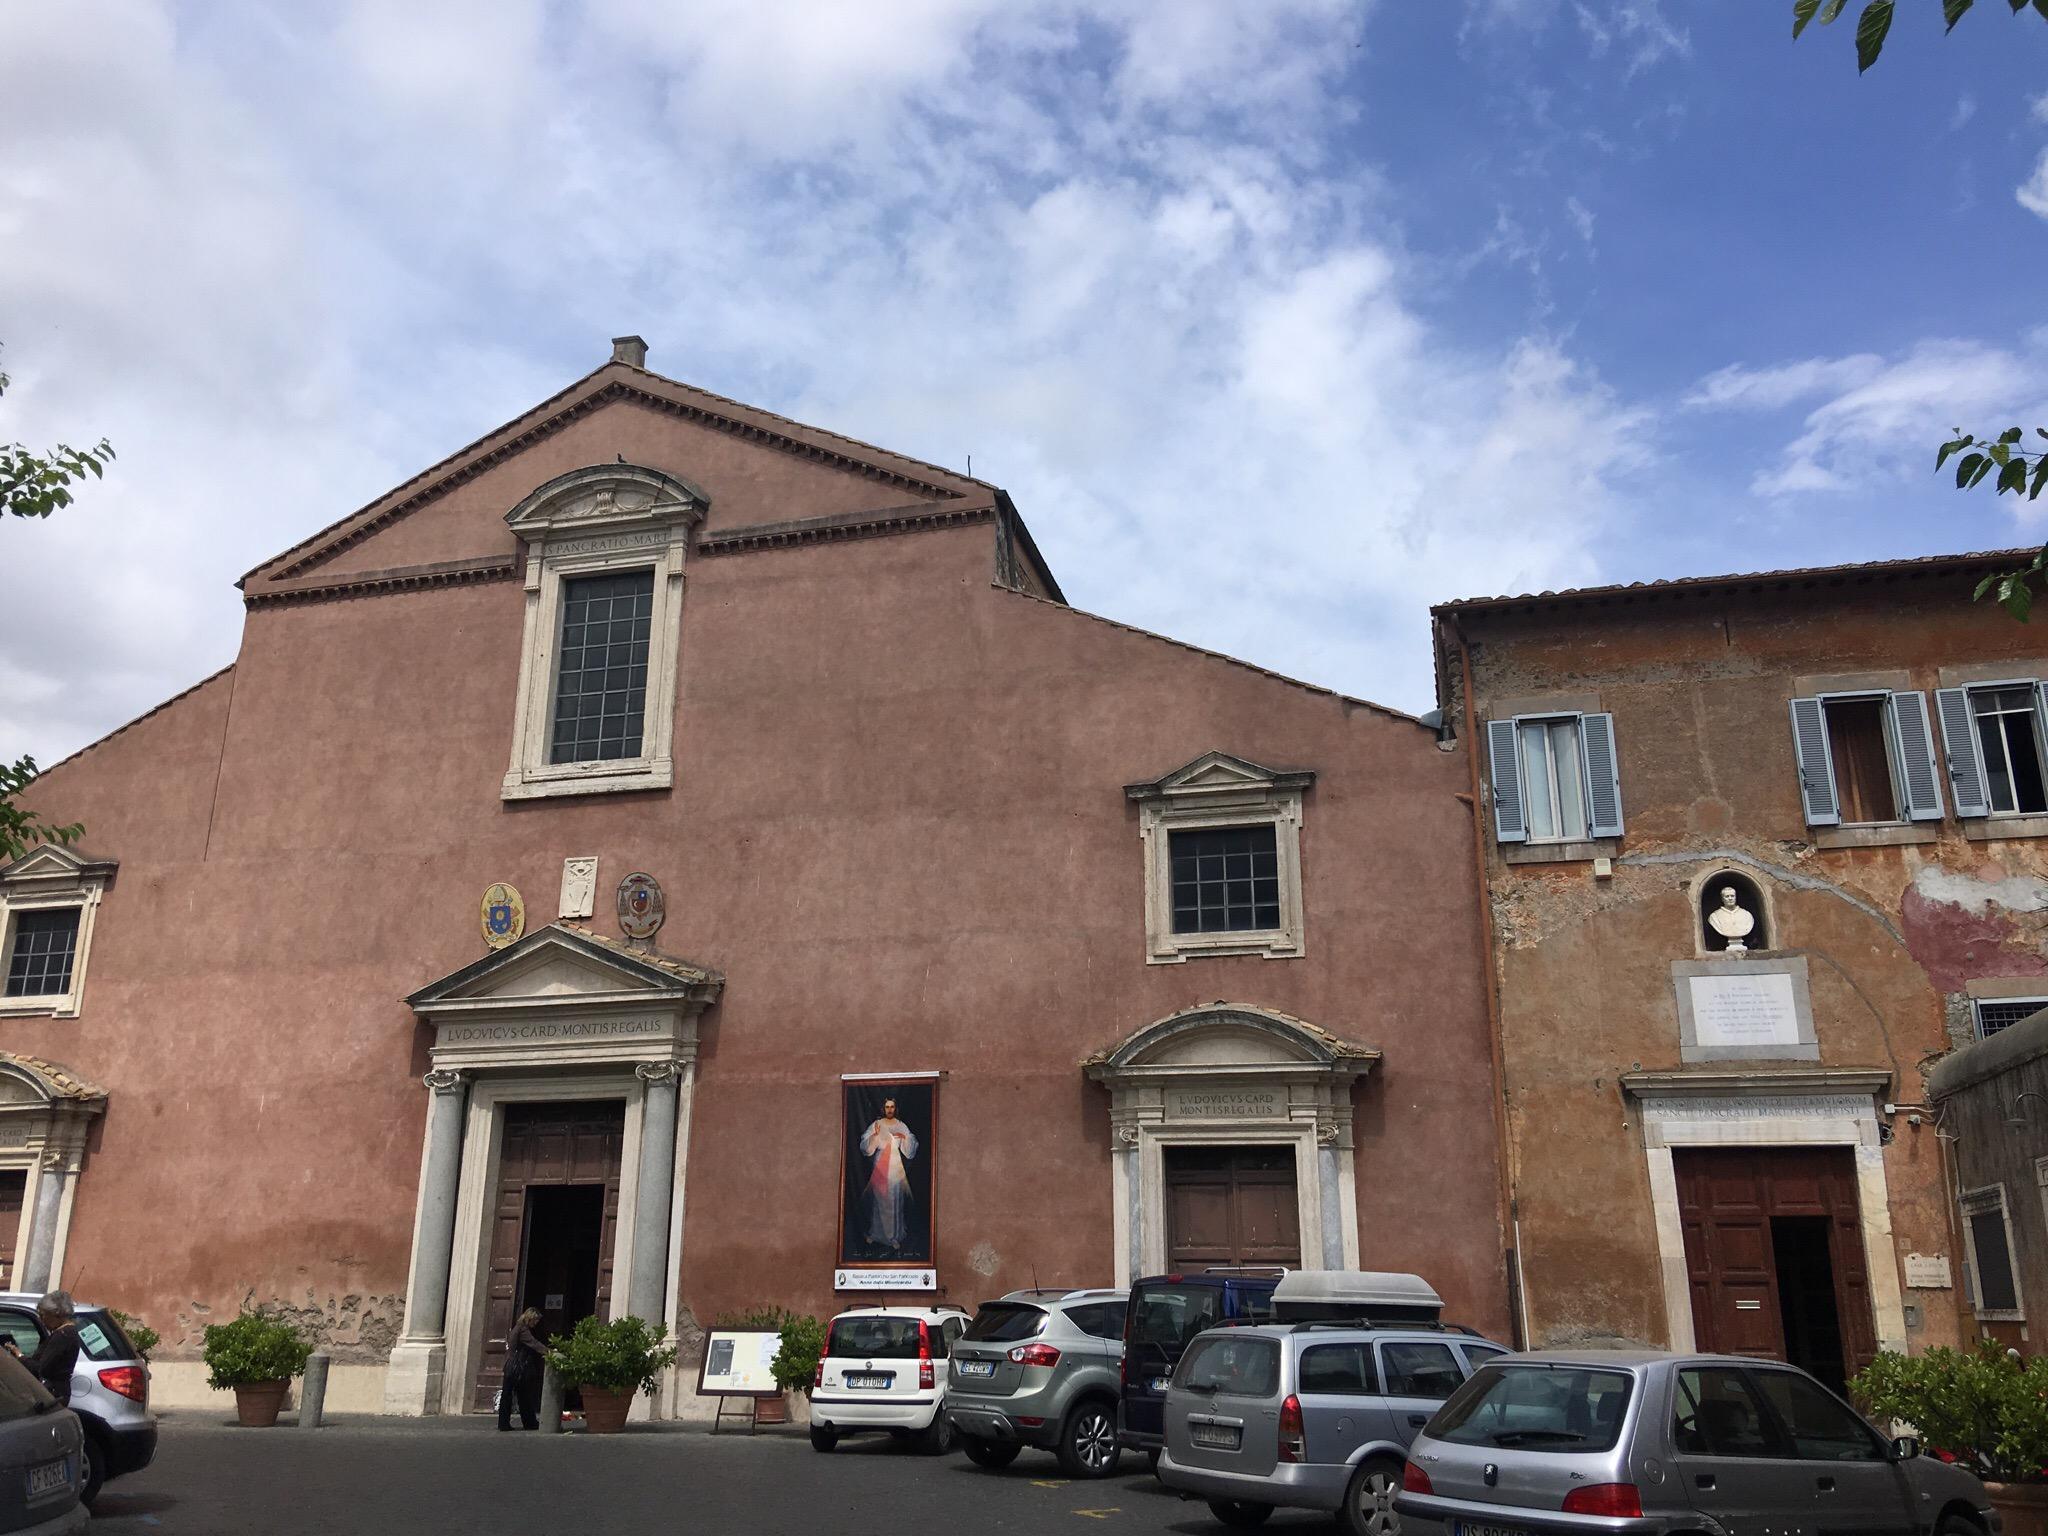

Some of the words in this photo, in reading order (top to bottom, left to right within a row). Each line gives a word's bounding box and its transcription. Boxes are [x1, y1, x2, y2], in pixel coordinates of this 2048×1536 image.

[556, 537, 629, 554] PANCRATIO
[448, 1026, 517, 1041] LVDOVICVS
[520, 1025, 557, 1038] CARD
[1179, 1095, 1243, 1105] LVDOVICVS
[1245, 1094, 1273, 1104] CARD
